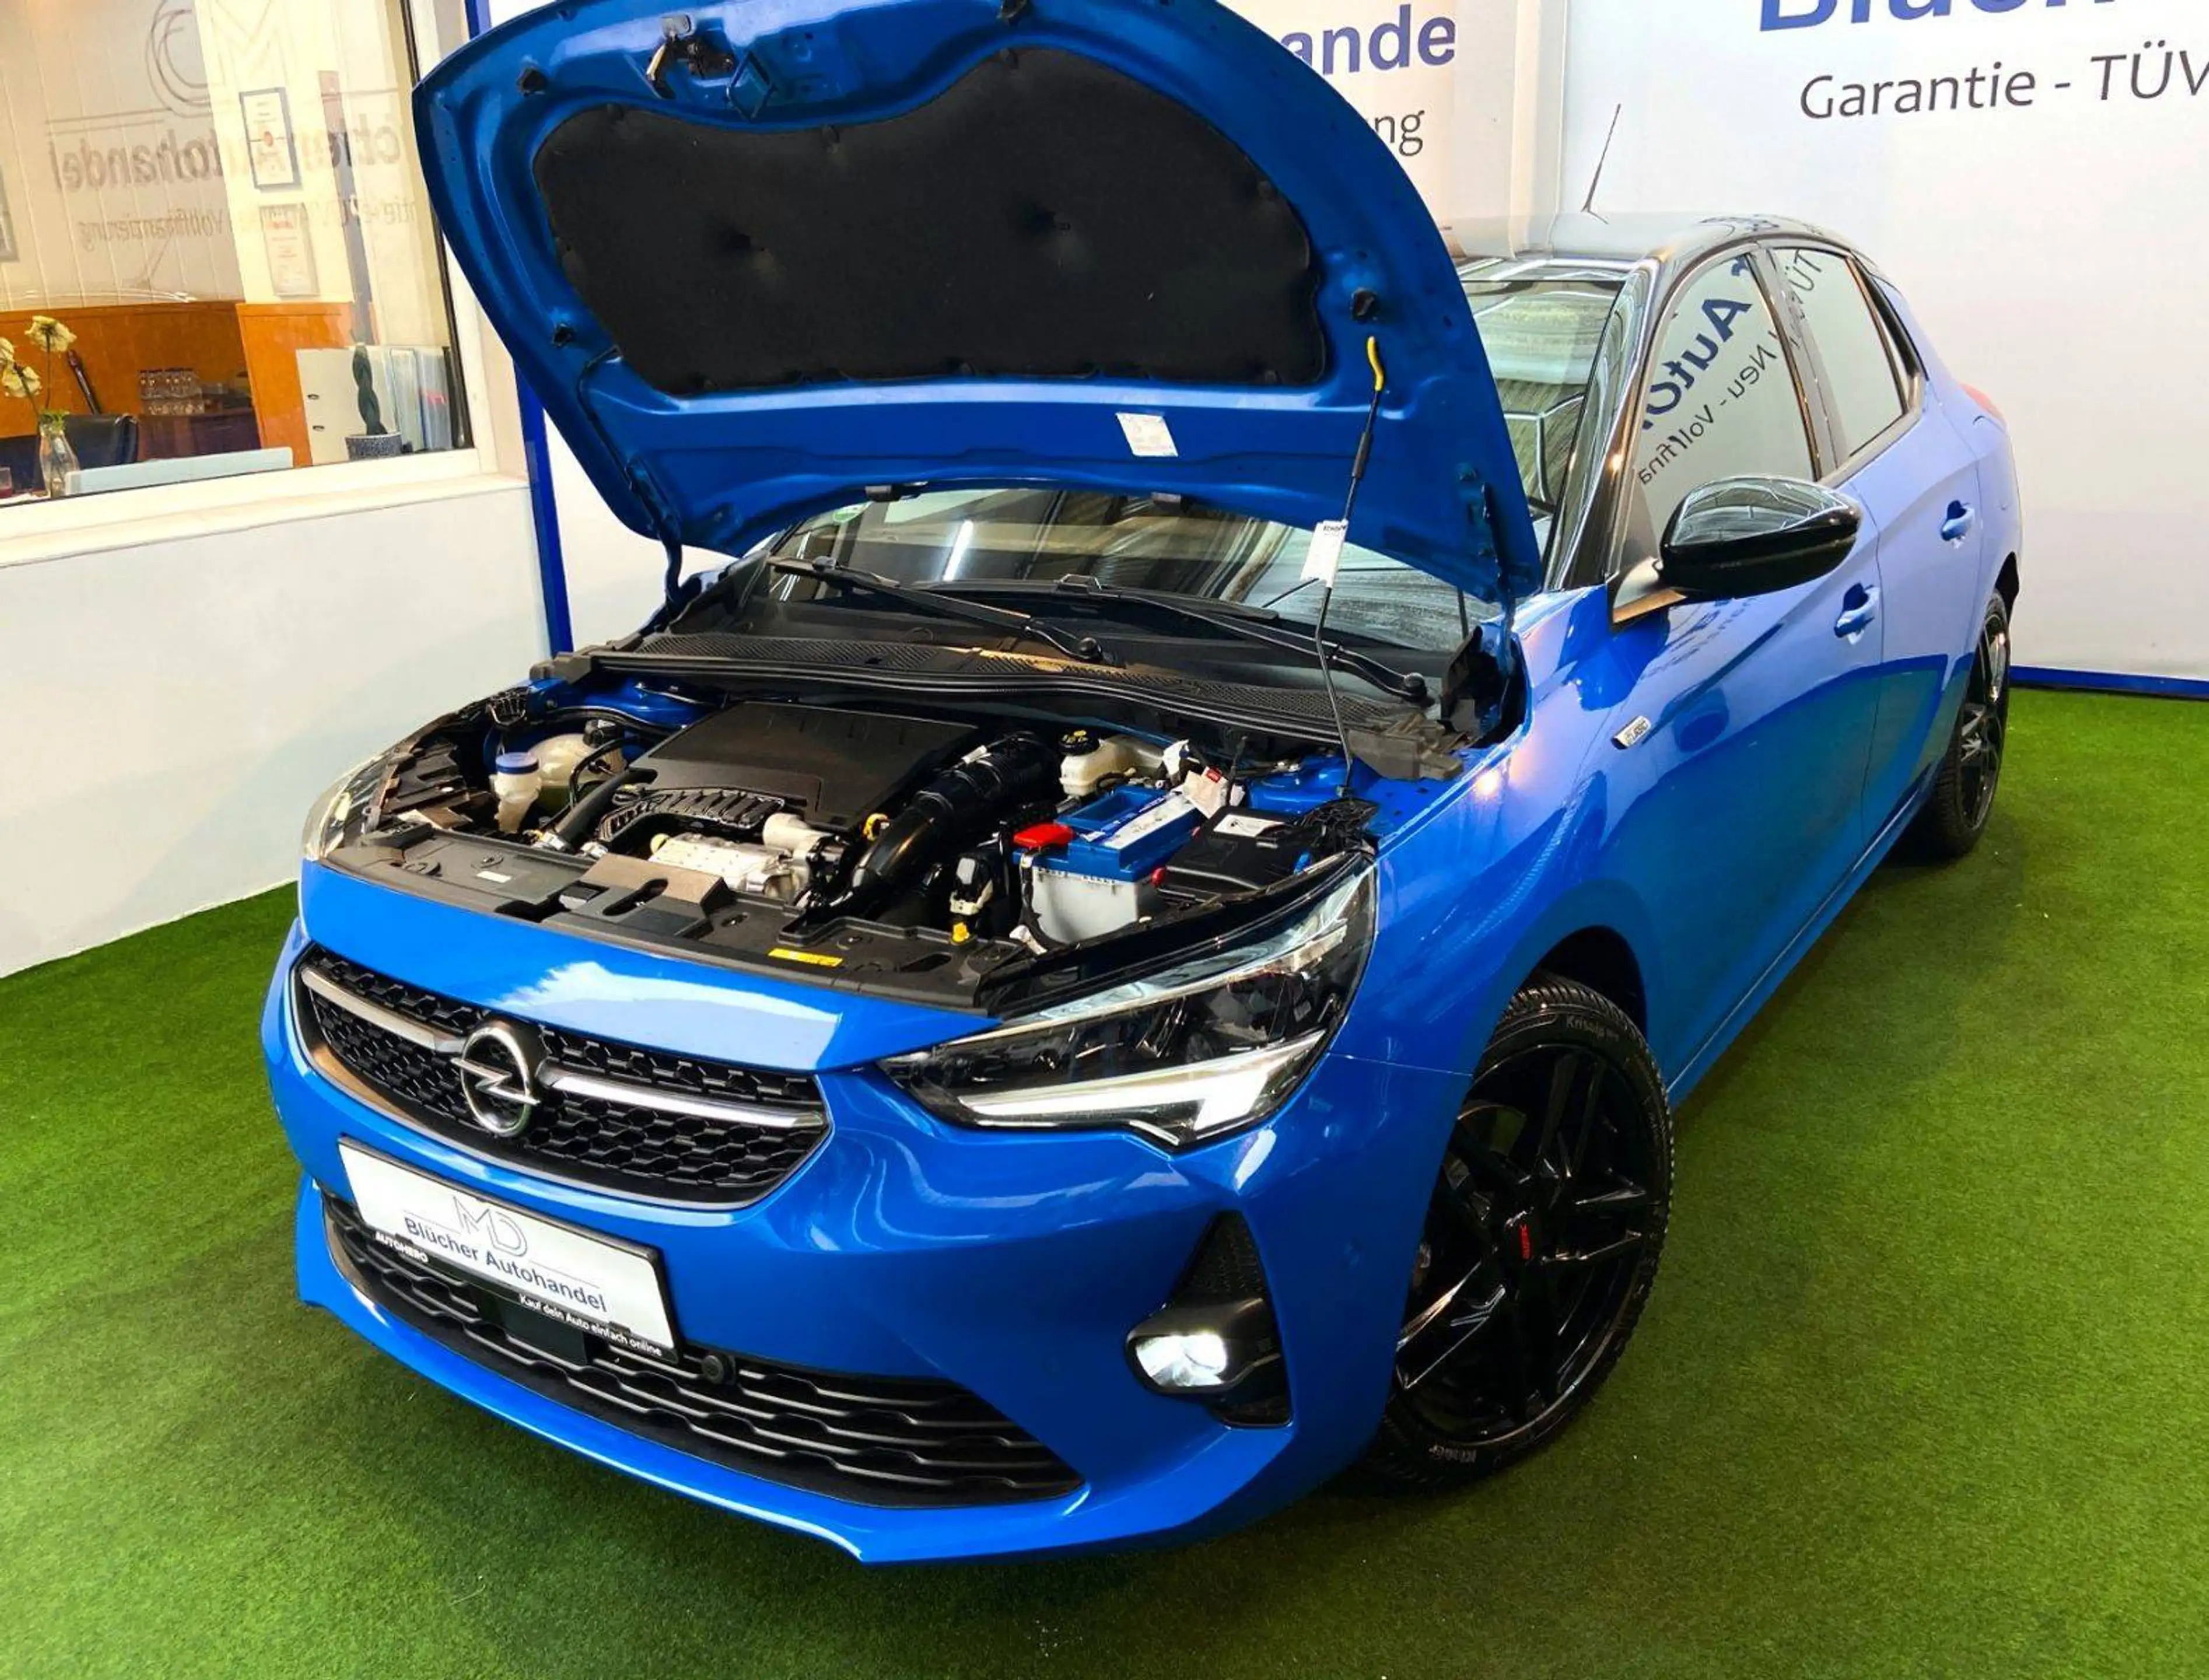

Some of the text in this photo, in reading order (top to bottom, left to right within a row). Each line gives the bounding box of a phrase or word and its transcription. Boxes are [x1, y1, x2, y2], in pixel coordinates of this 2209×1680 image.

[1800, 62, 2036, 119] Garantie
[2091, 39, 2209, 99] TÜV
[404, 1216, 608, 1312] Blücher Autohandel
[565, 1313, 591, 1331] Auto
